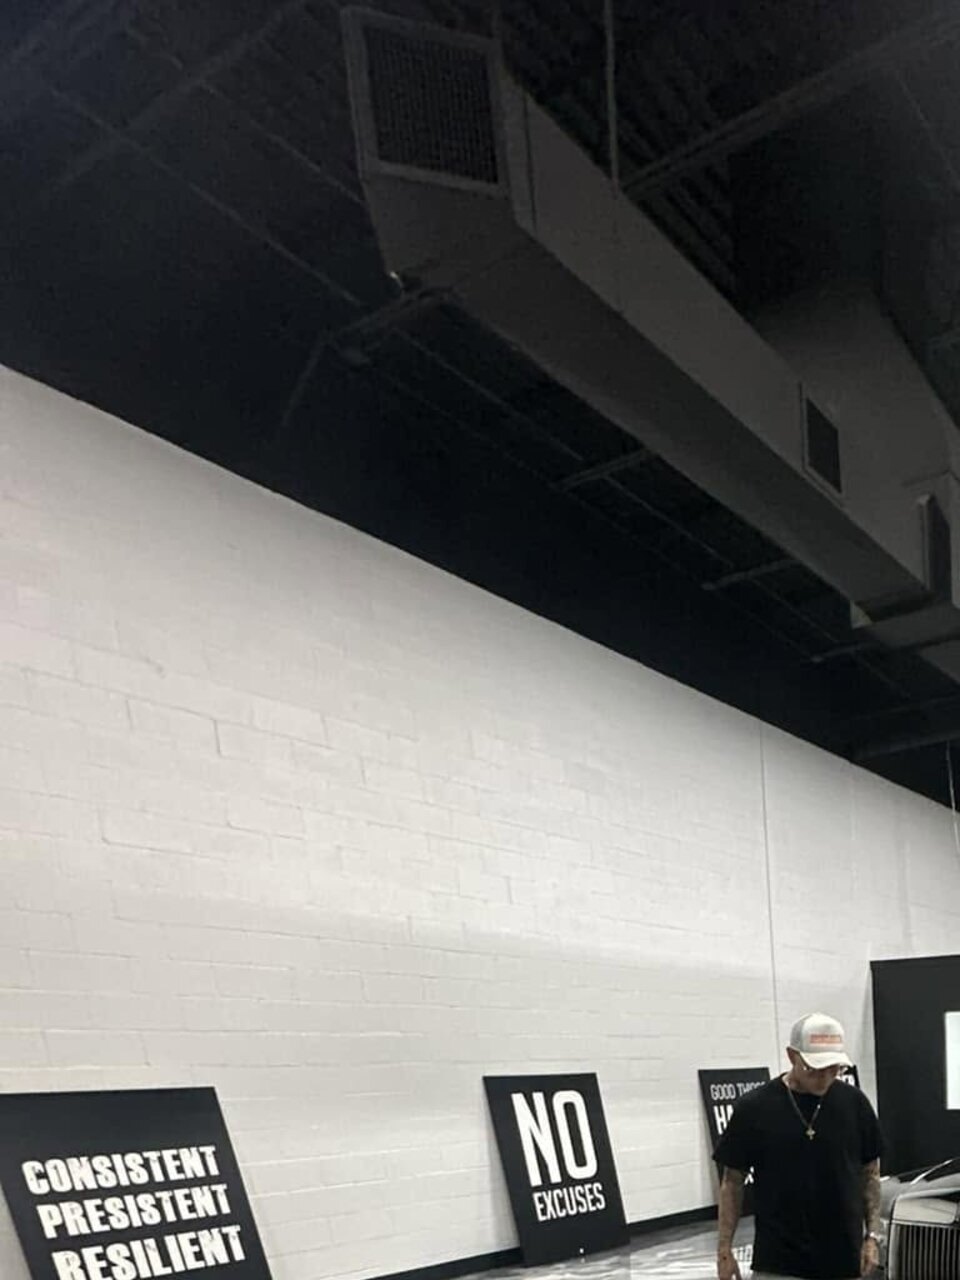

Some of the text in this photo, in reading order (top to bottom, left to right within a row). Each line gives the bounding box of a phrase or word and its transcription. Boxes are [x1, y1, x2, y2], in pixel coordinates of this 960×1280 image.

[710, 1083, 737, 1101] GOOD
[510, 1089, 598, 1188] NO
[21, 1145, 220, 1195] CONSISTENT
[36, 1183, 232, 1239] PRESISTENT
[532, 1182, 606, 1223] EXCUSES
